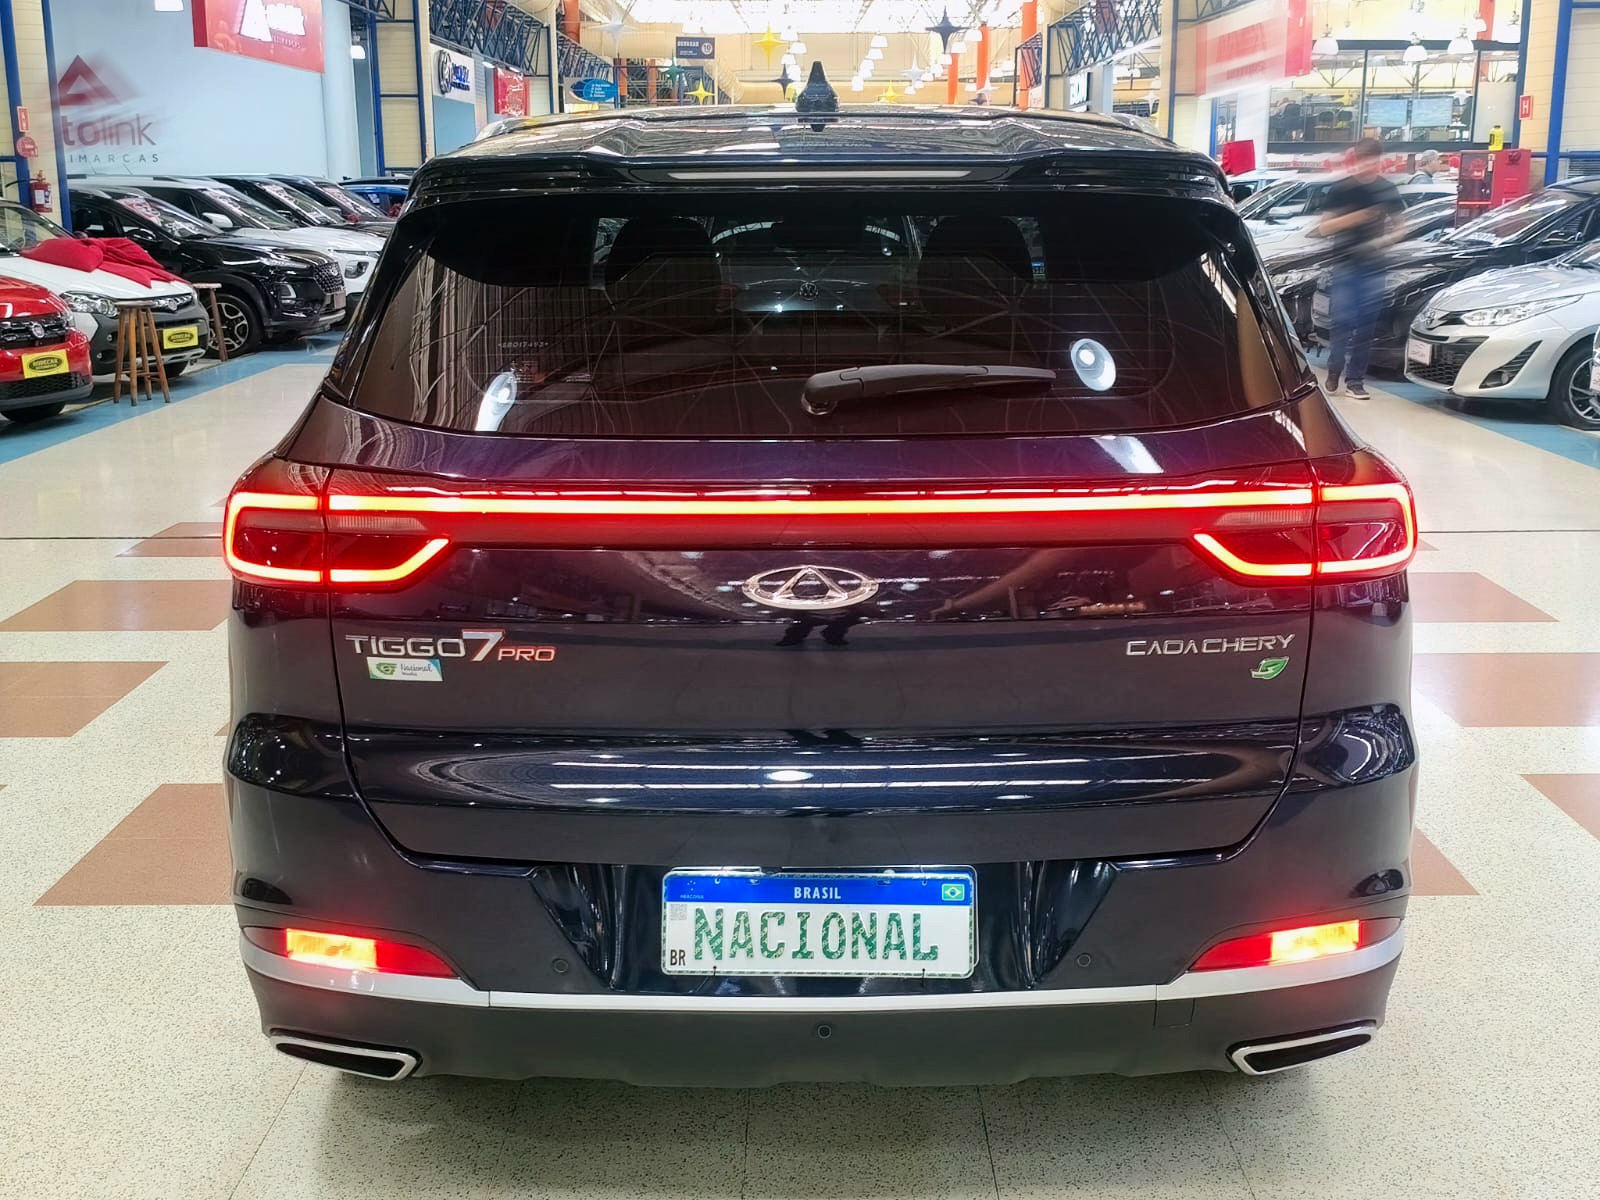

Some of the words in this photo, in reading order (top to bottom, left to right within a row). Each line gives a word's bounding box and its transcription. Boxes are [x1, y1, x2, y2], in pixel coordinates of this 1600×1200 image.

[345, 635, 466, 657] TIGGO
[462, 629, 505, 661] 7
[497, 645, 556, 662] PRO
[1126, 639, 1198, 656] CAOA
[1202, 634, 1296, 653] CHERY
[793, 886, 842, 900] BRASIL
[694, 908, 939, 961] NACIONAL
[670, 949, 687, 967] BR
